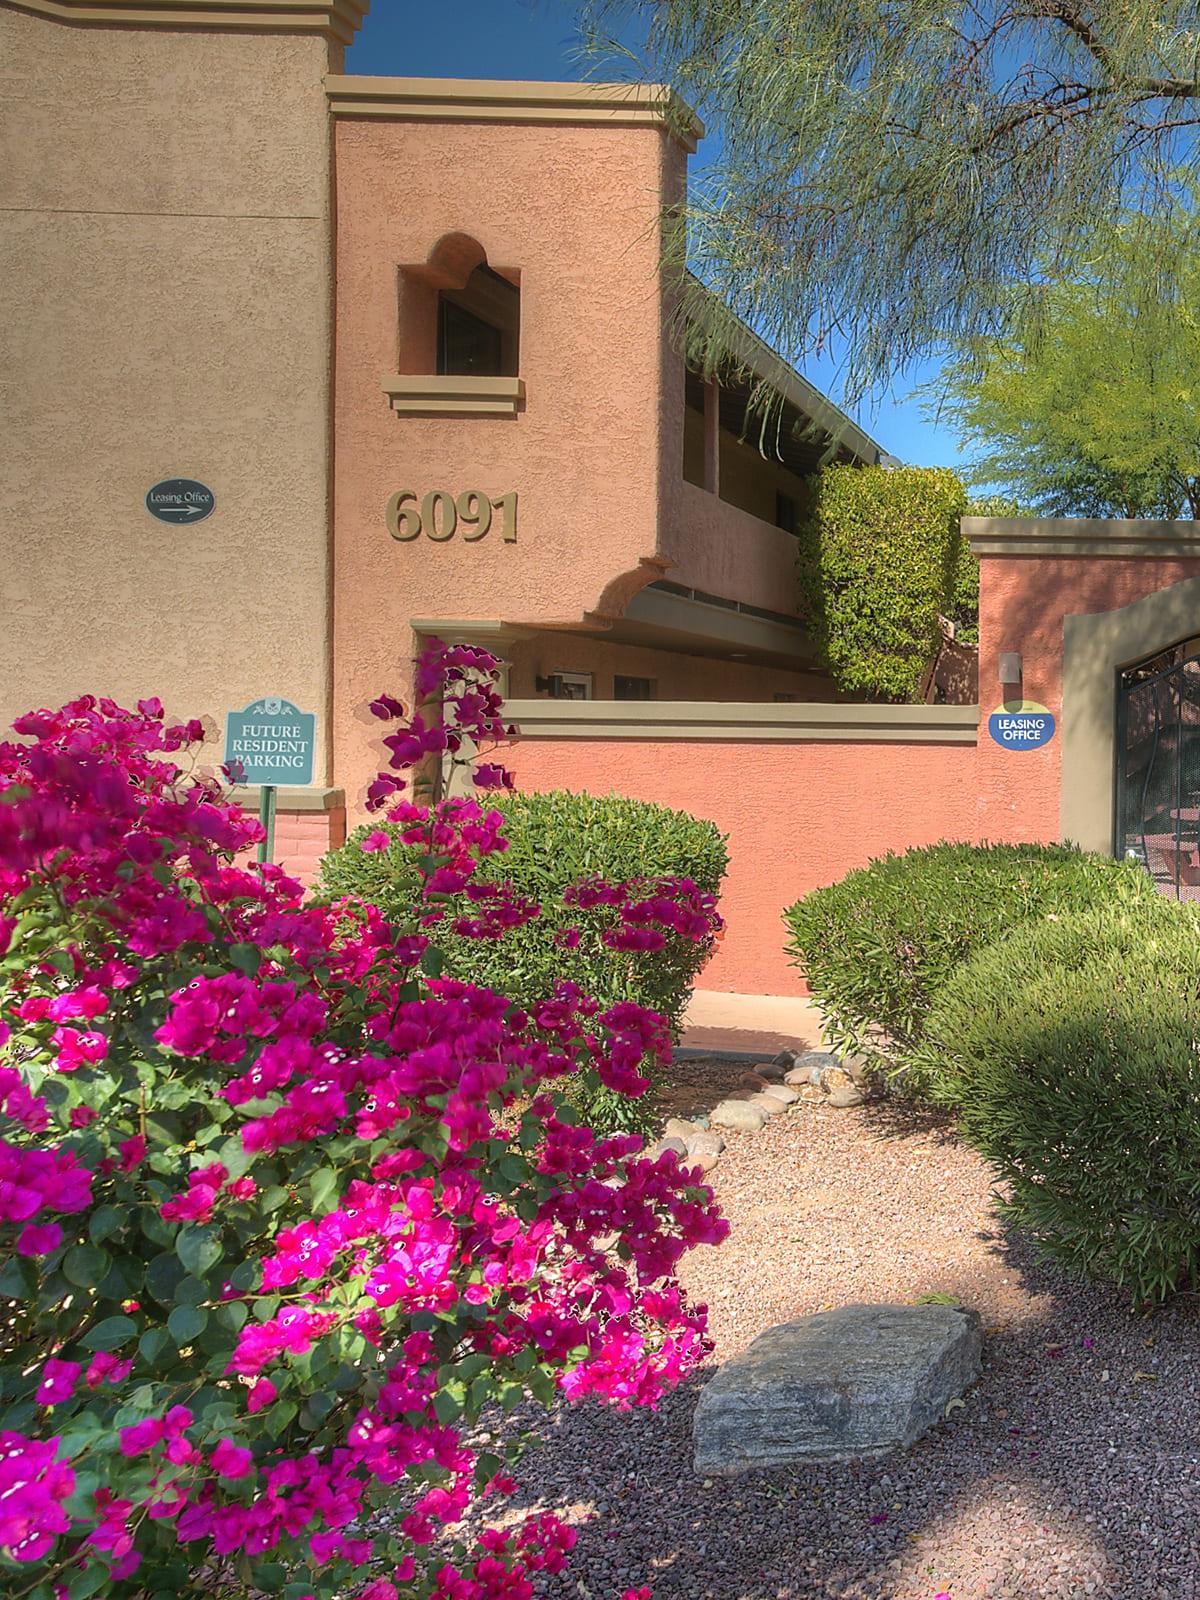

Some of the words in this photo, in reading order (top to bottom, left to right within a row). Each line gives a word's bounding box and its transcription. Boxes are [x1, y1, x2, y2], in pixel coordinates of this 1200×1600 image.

[150, 492, 182, 504] Leasing
[184, 491, 210, 502] Office
[385, 489, 519, 544] 6091
[998, 719, 1045, 730] LEASING
[242, 725, 302, 738] FUTURE
[1003, 730, 1041, 741] OFFICE
[232, 739, 309, 753] RESIDENT
[234, 754, 305, 768] PARKING
